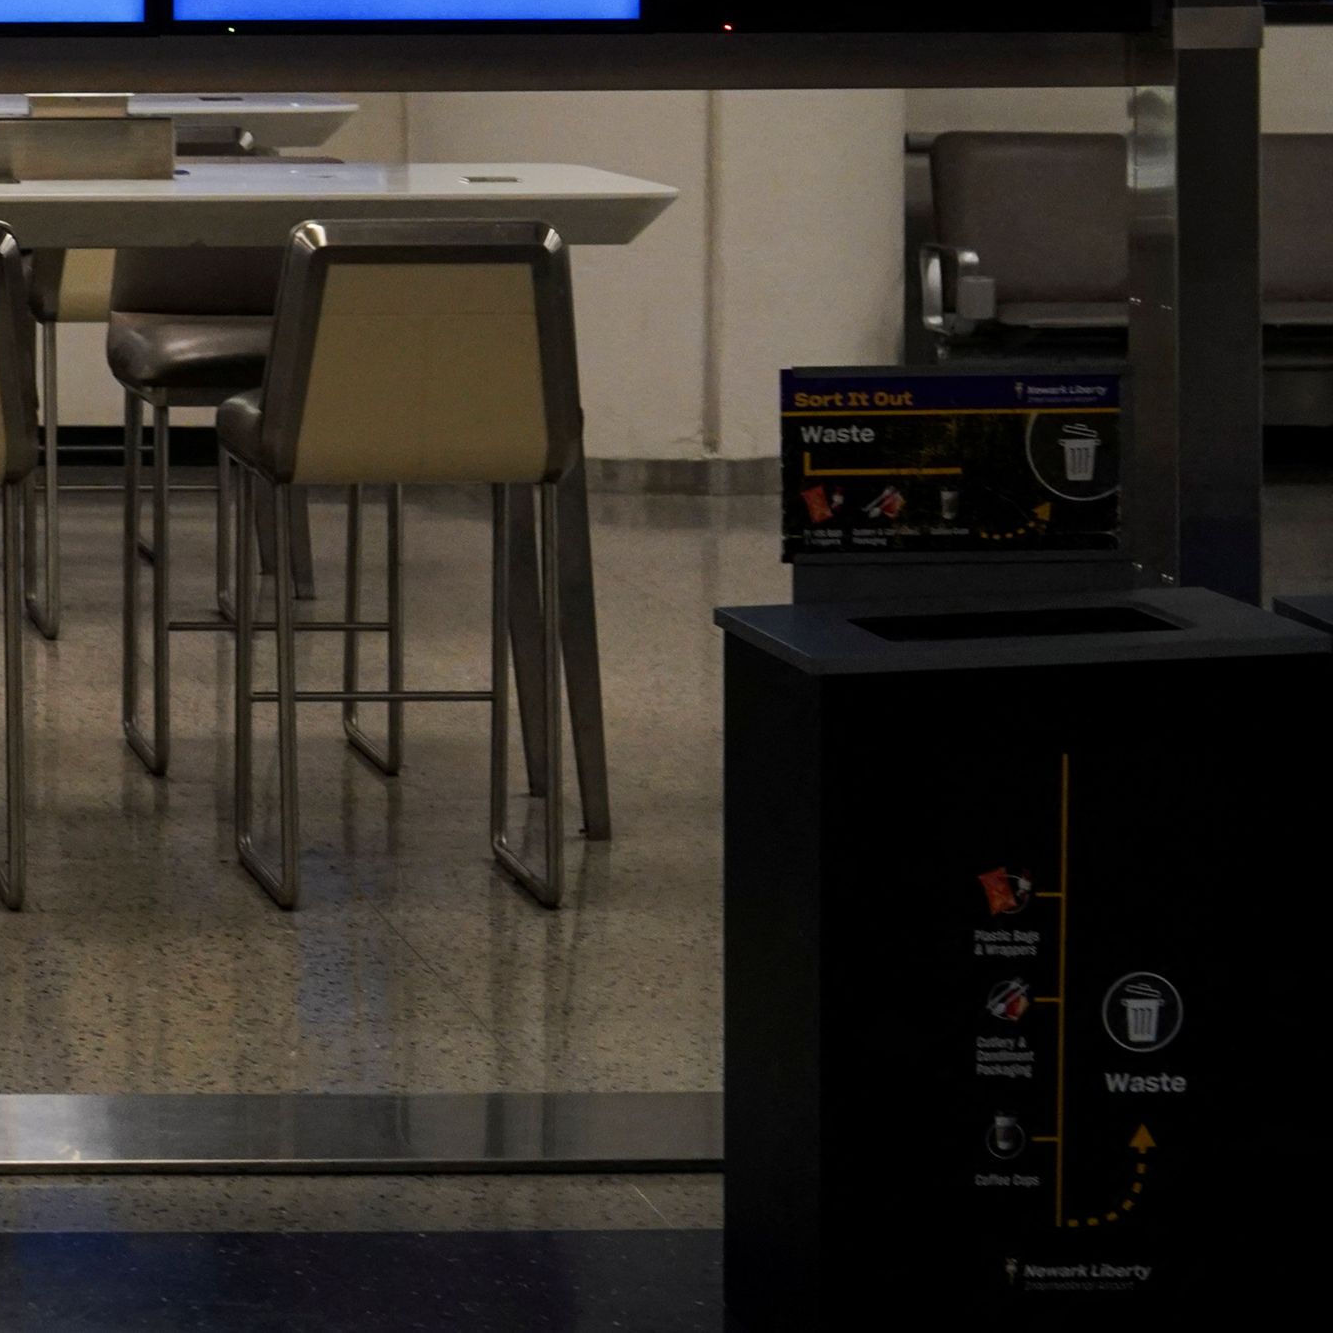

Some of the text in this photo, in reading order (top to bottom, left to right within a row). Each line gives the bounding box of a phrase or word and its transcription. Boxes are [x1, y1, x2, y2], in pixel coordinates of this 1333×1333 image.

[794, 389, 913, 408] Sort It Out
[800, 424, 875, 444] Waste
[1104, 1071, 1188, 1094] Waste
[1023, 1263, 1152, 1281] Newark Liberty
